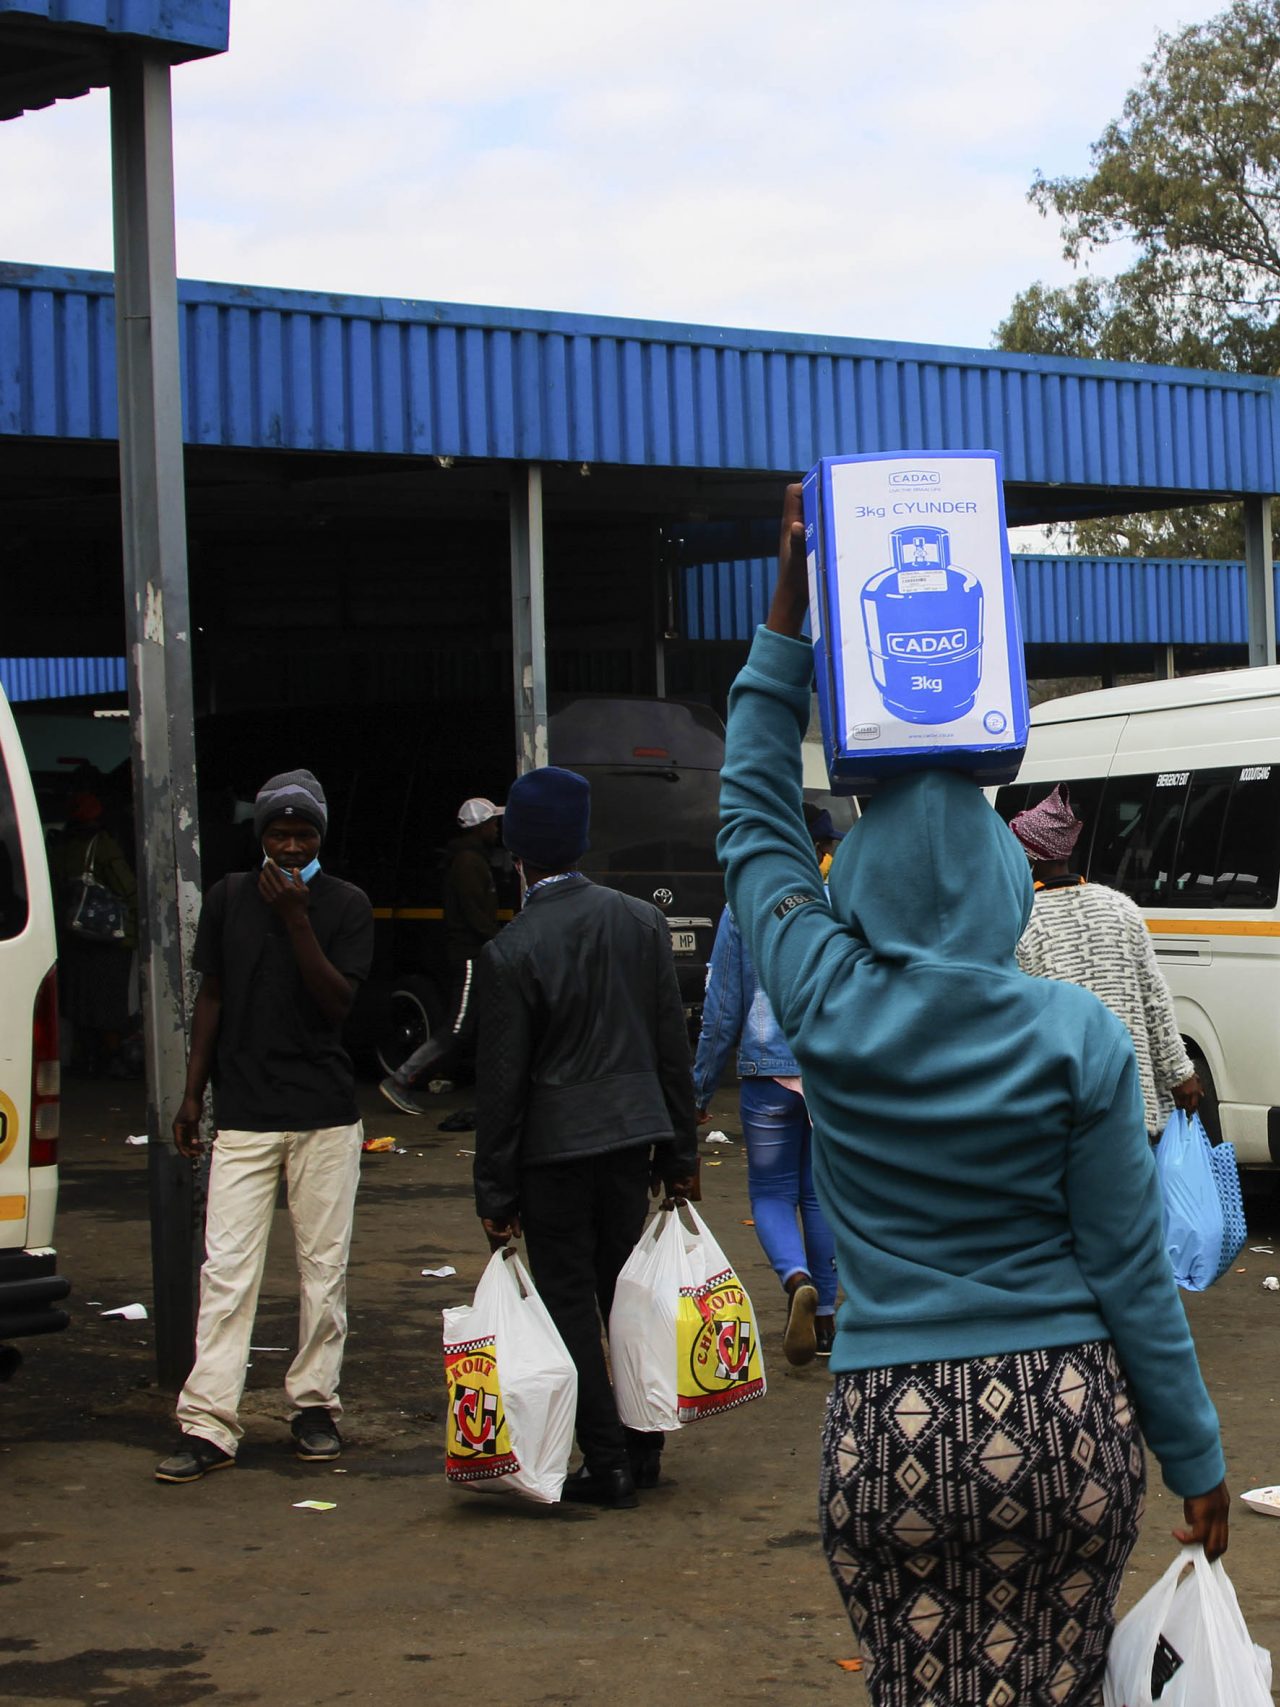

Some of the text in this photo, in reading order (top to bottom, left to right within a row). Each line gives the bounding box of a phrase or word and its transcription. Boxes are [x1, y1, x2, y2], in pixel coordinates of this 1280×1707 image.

[893, 474, 938, 483] CADAC
[856, 501, 977, 518] 3kg CYLINDER
[891, 633, 963, 652] CADAC
[911, 676, 943, 692] 3kg
[679, 934, 694, 948] MP
